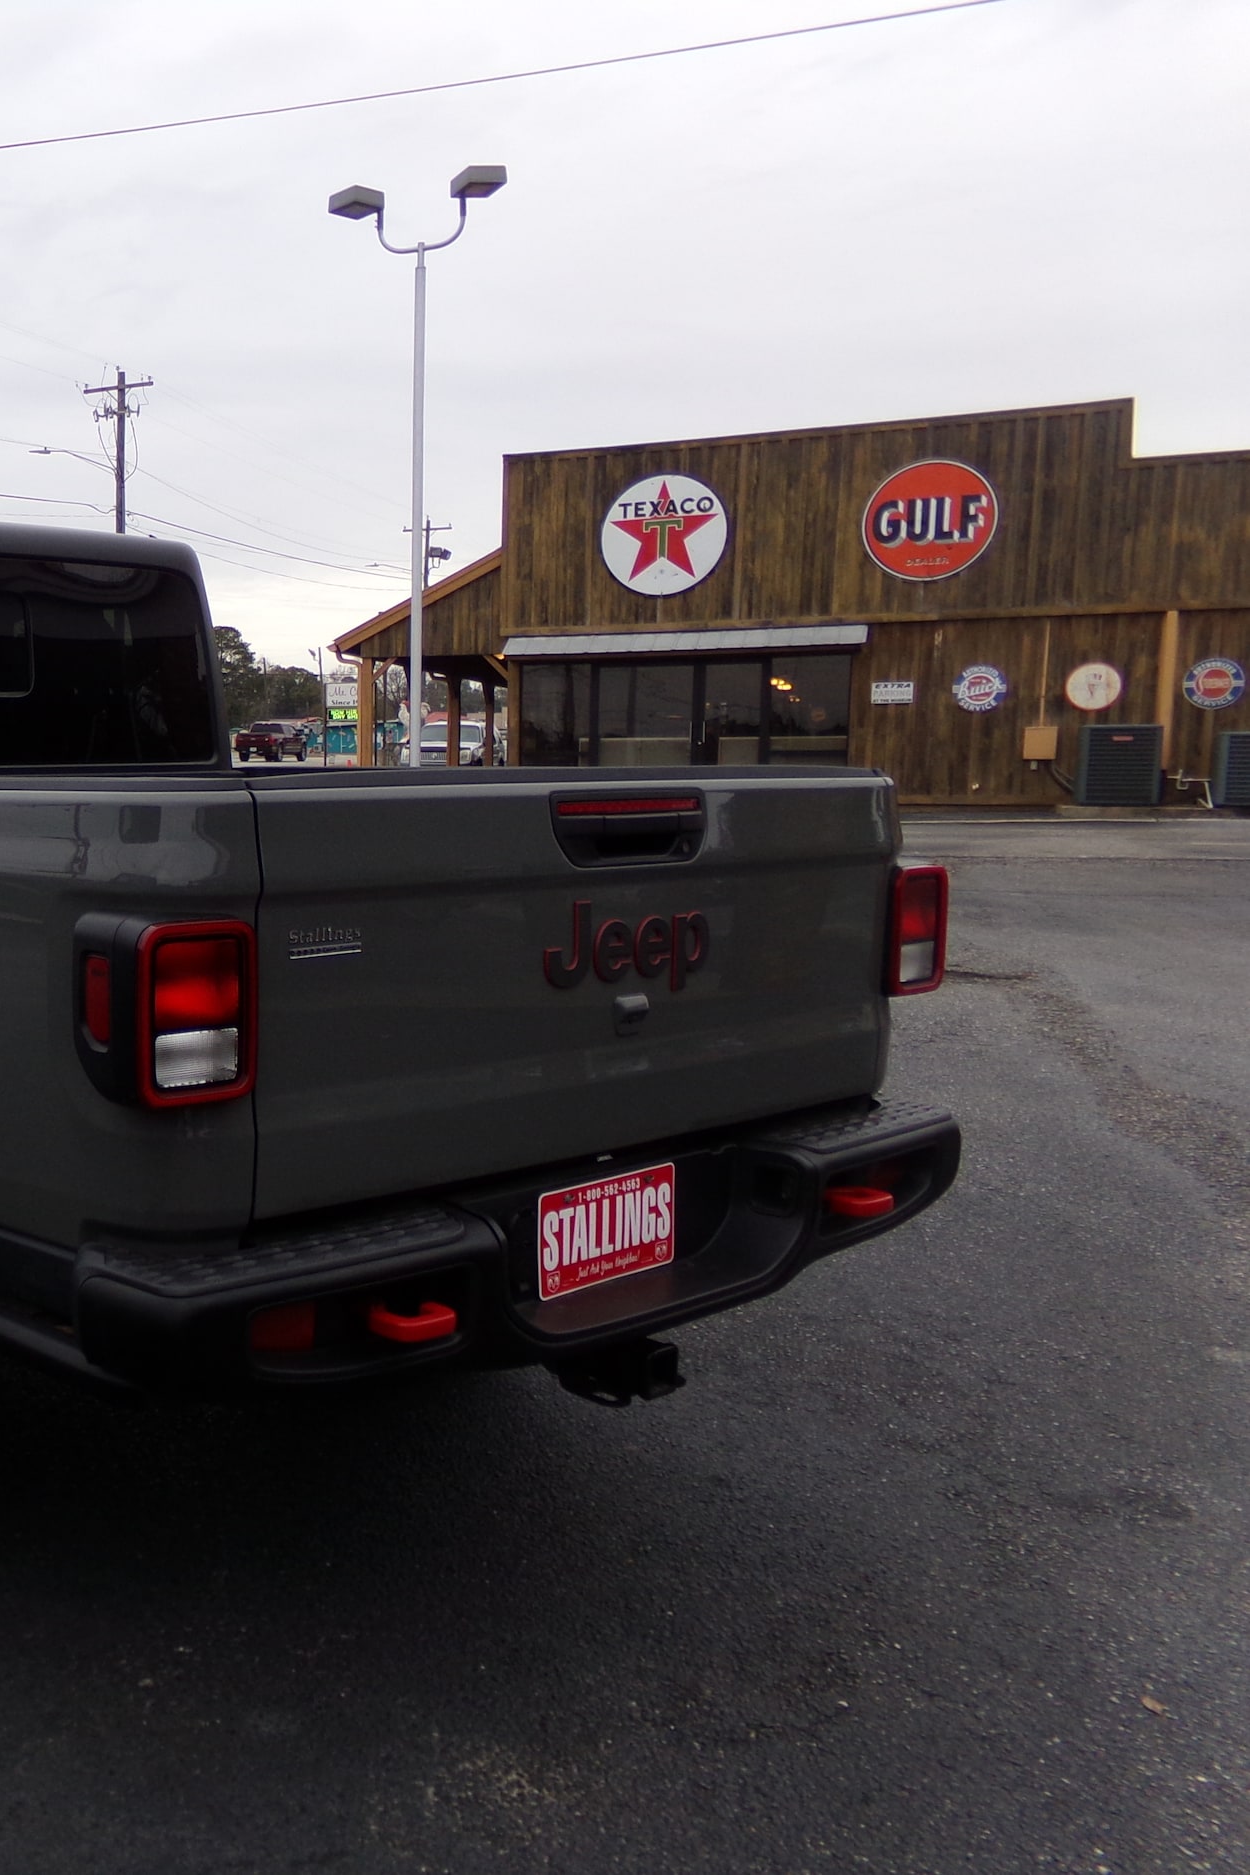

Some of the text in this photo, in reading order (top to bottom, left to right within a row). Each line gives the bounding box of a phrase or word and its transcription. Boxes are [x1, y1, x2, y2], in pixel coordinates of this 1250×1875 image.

[618, 496, 714, 519] TEXACO
[872, 494, 988, 549] GULF
[643, 518, 684, 561] T
[905, 557, 951, 567] DEALER
[958, 677, 1003, 699] Buick
[958, 699, 998, 711] SERVICE
[288, 925, 362, 944] Stallings
[543, 900, 710, 992] Jeep
[543, 1182, 672, 1272] STALLINGS
[576, 1266, 589, 1281] Just
[590, 1262, 600, 1275] Ask
[601, 1260, 614, 1276] Your
